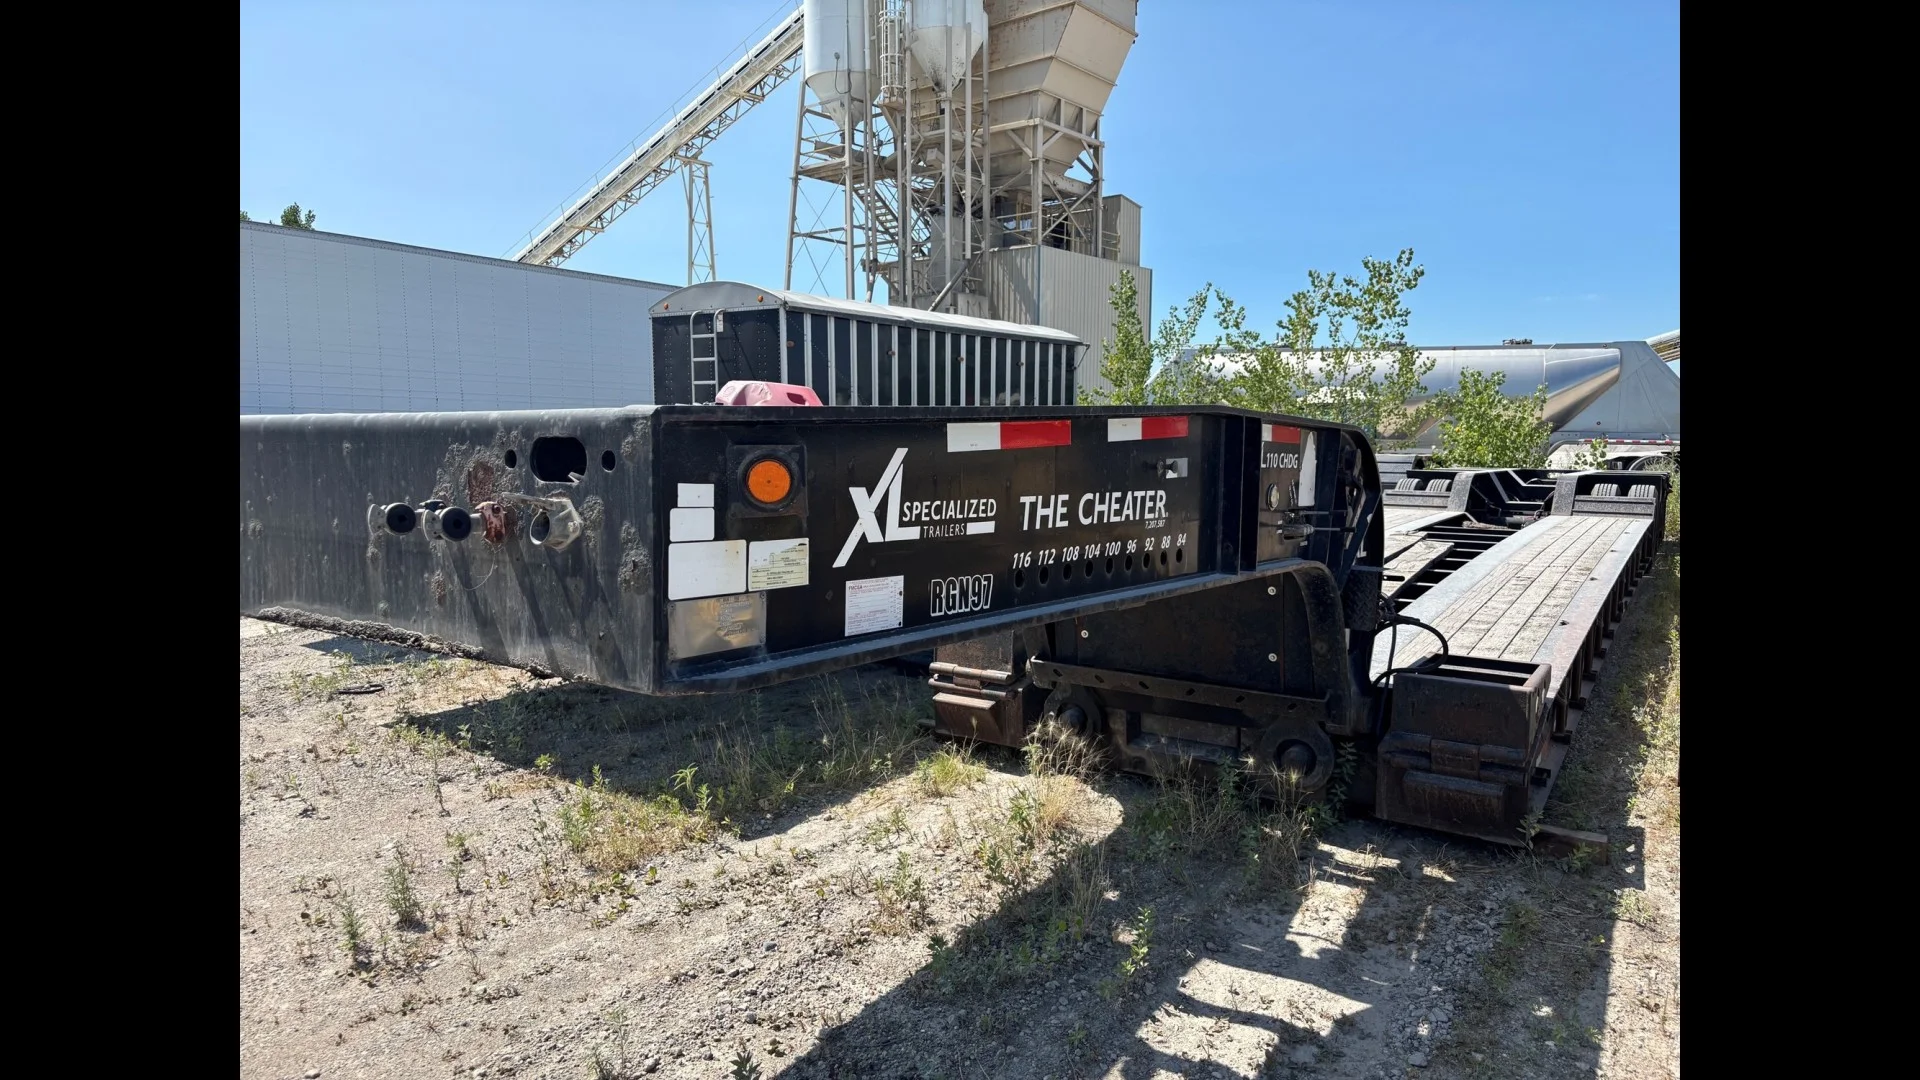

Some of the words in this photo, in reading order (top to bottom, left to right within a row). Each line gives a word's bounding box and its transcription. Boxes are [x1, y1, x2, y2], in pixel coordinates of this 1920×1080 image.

[1279, 452, 1299, 469] CHDG
[832, 447, 921, 568] XL
[902, 498, 997, 522] SPECIALIZED
[1019, 494, 1070, 531] THE
[923, 523, 965, 539] TRAILERS
[1012, 551, 1032, 569] 116
[1038, 548, 1056, 566] 112
[1061, 545, 1080, 563] 108
[1083, 543, 1101, 560] 104
[1104, 541, 1121, 557] 100
[1125, 539, 1137, 554] 96
[1144, 537, 1155, 552] 92
[1160, 535, 1171, 549] 88
[1176, 533, 1187, 547] 84
[930, 573, 994, 617] RGN97
